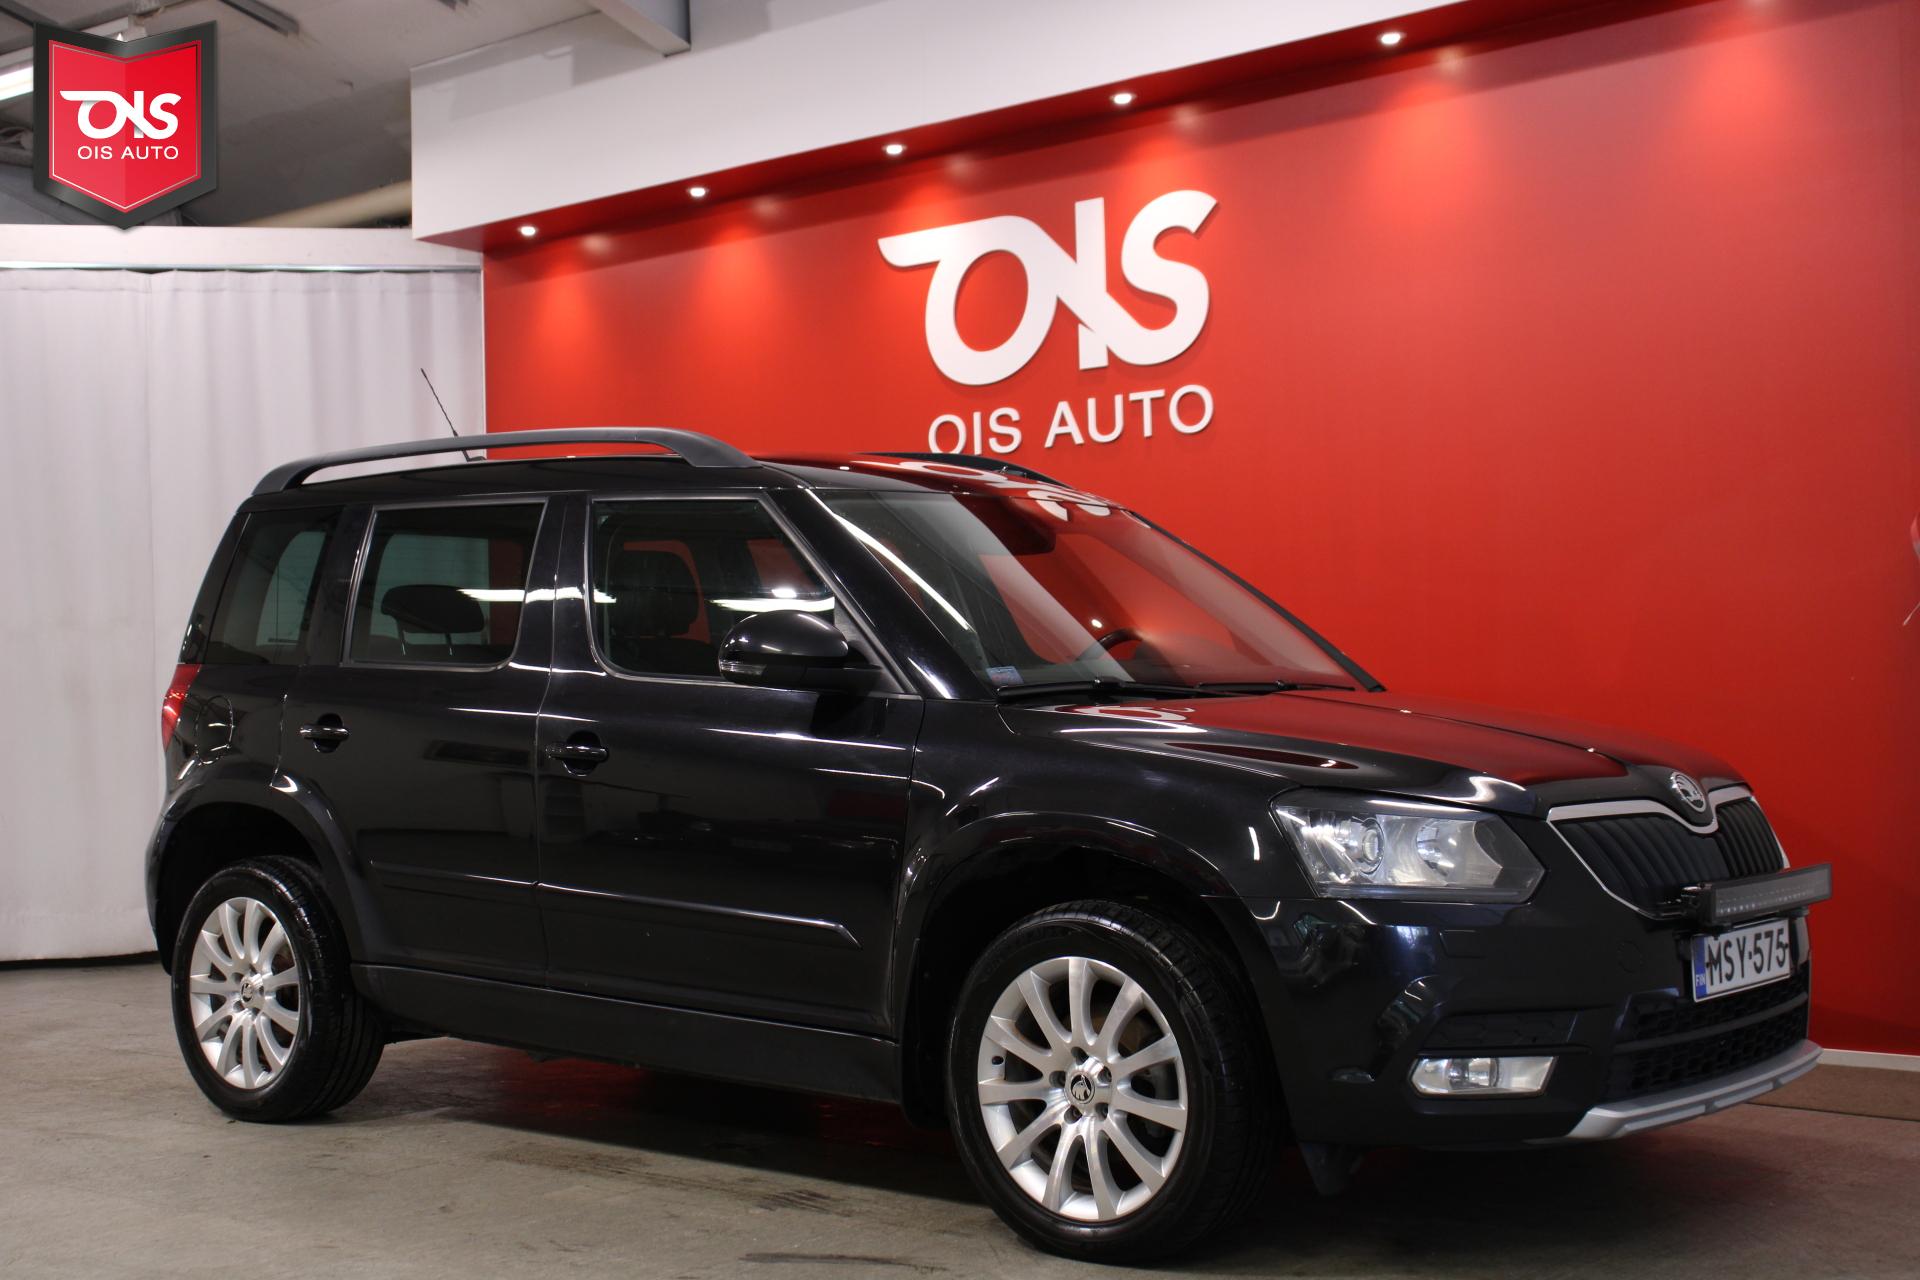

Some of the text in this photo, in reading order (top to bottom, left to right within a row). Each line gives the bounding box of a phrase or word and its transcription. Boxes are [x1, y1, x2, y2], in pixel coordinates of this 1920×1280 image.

[878, 190, 1217, 386] OIS
[928, 384, 1214, 455] OIS AUTO
[1695, 973, 1706, 987] FIN
[1706, 928, 1788, 986] MSY-575
